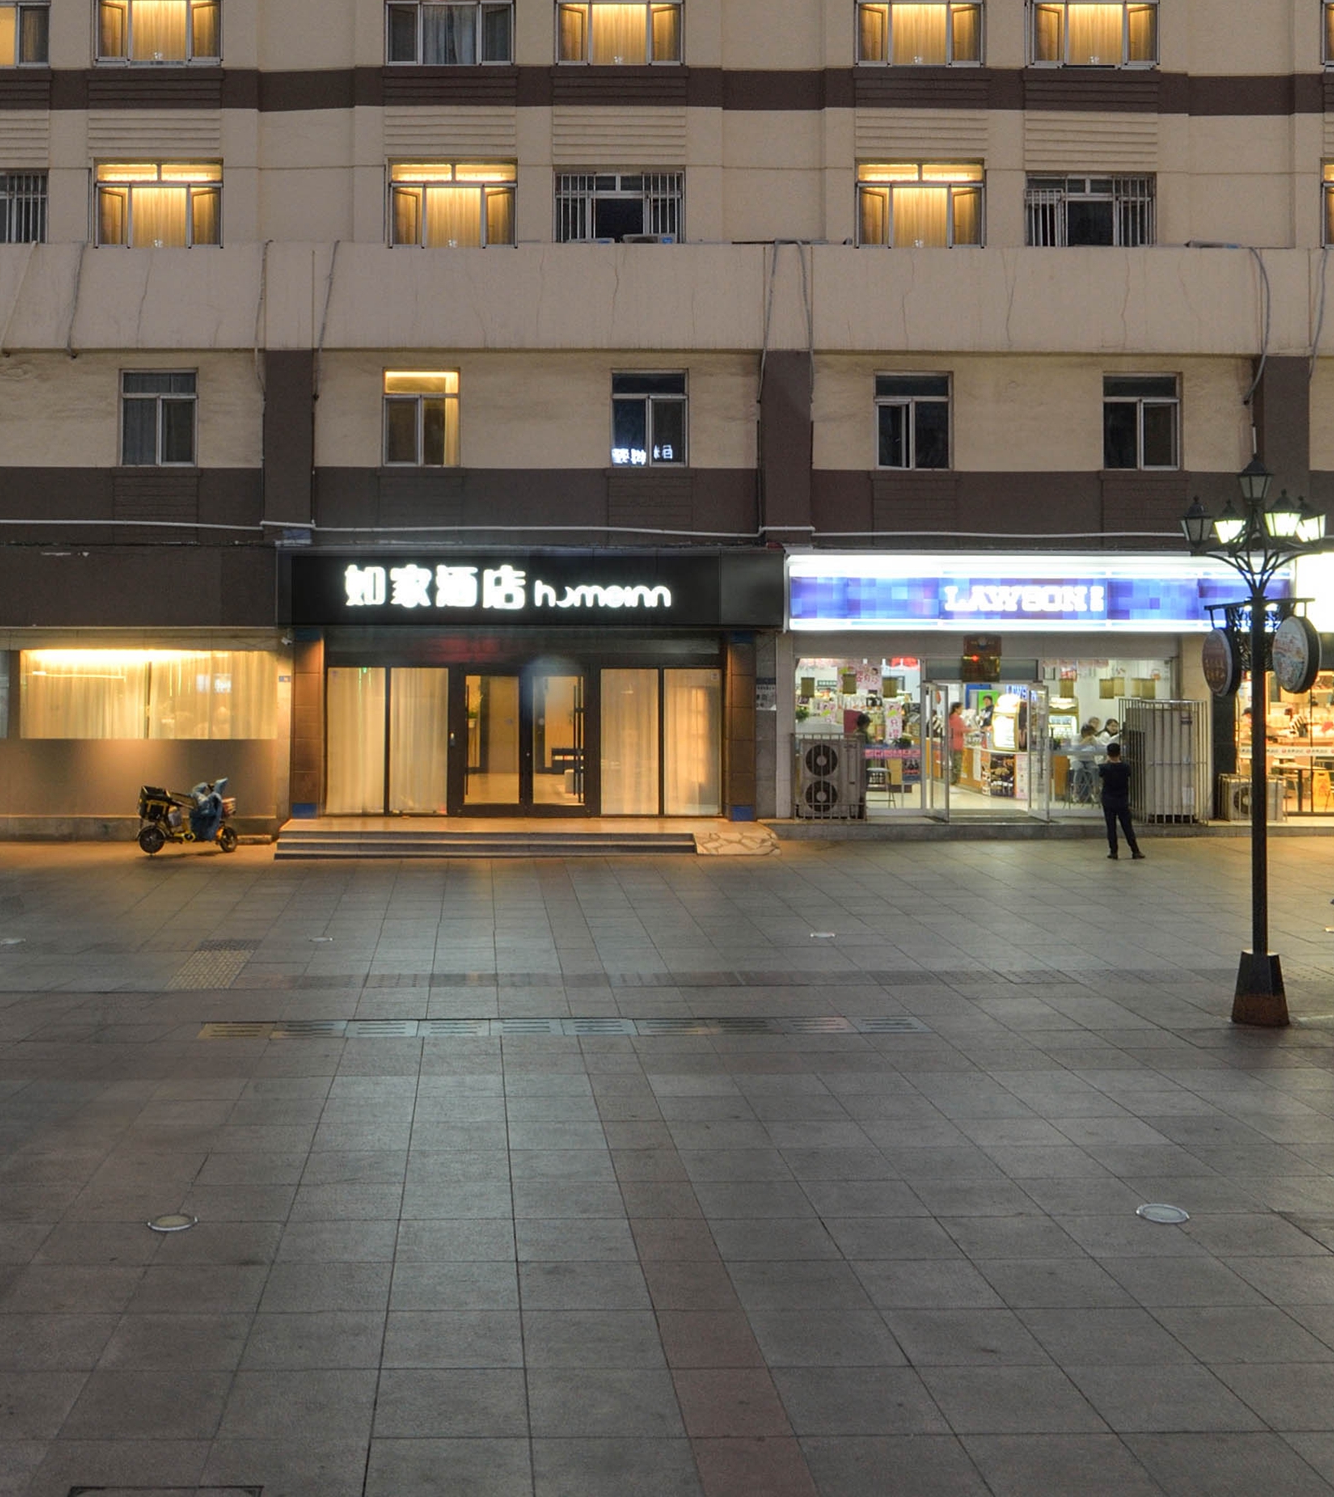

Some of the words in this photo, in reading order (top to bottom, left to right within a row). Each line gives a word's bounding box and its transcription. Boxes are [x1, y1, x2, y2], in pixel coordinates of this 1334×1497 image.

[345, 564, 525, 609] 如家酒店
[944, 585, 1088, 611] LAWSON
